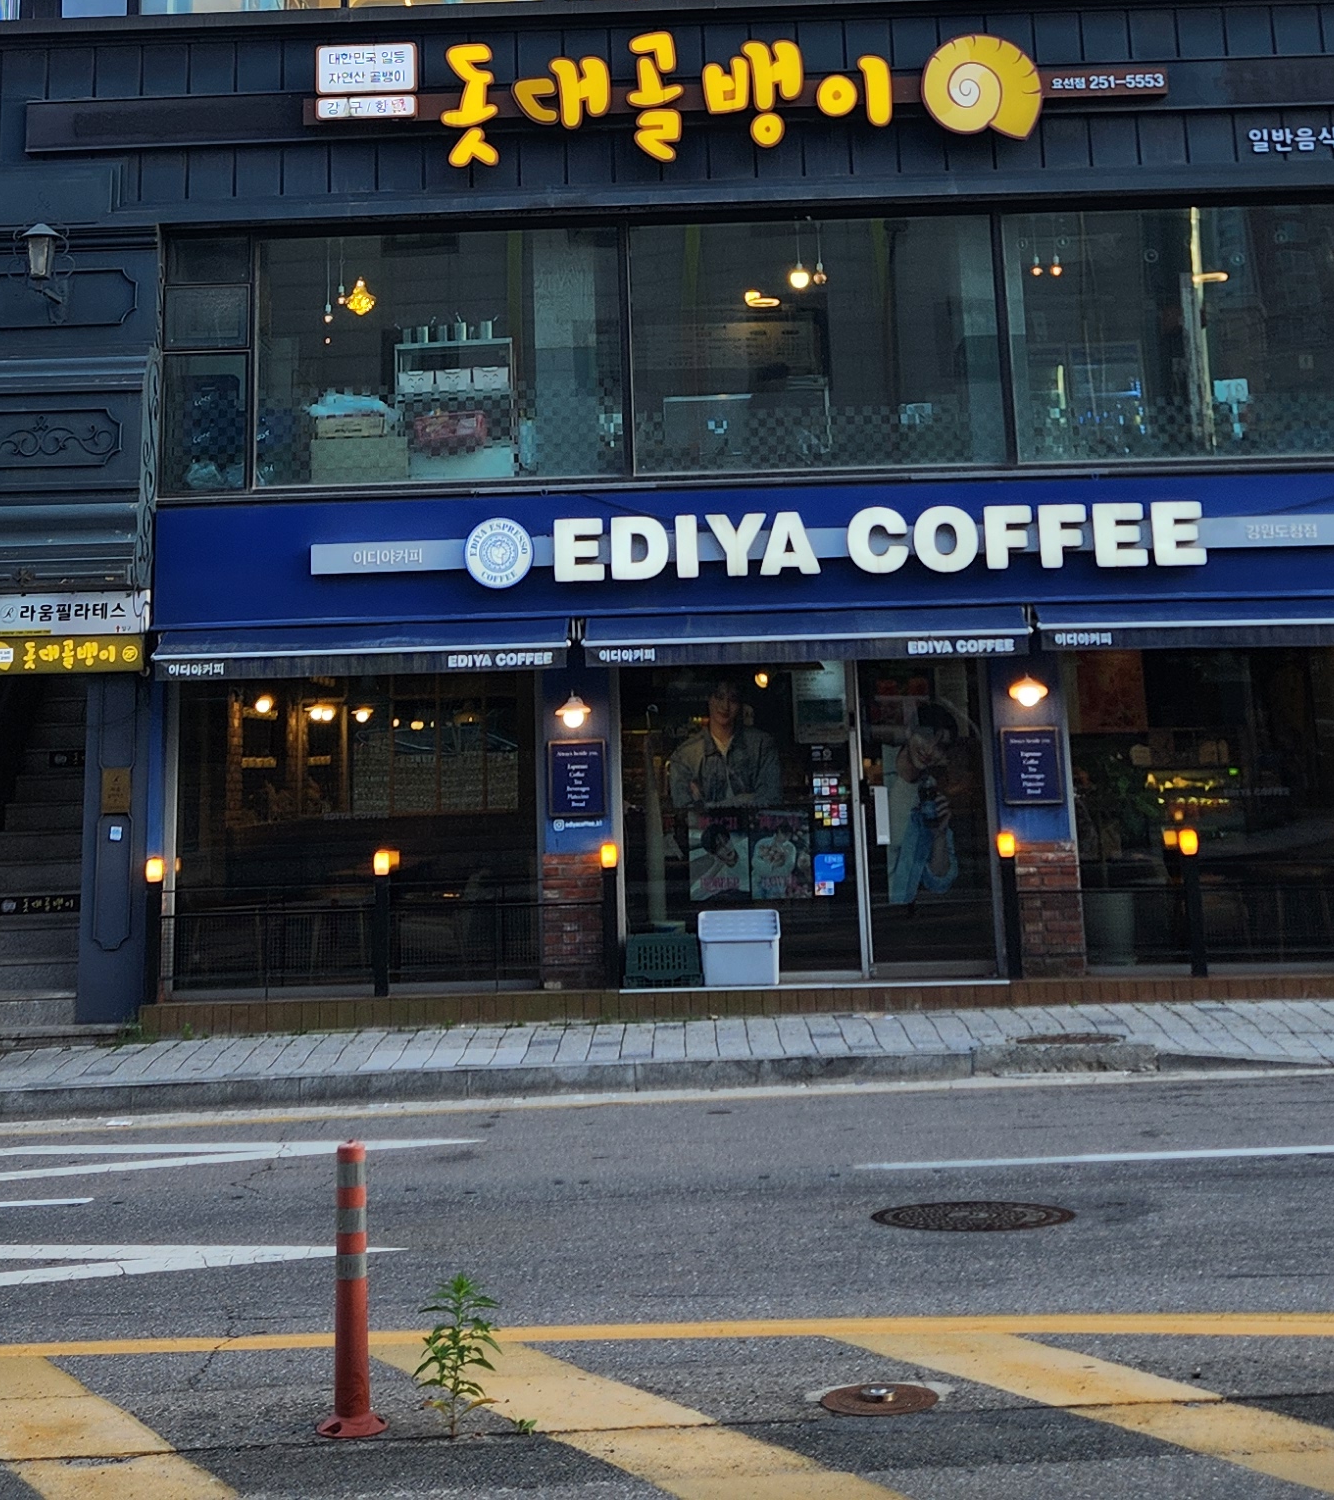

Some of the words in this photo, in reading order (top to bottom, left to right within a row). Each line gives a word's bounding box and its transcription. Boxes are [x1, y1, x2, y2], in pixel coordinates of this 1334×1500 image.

[328, 52, 376, 65] 대한민국
[381, 51, 405, 64] 일등
[328, 71, 366, 84] 자연산
[370, 70, 405, 83] 골뱅이
[1051, 76, 1086, 89] 요선점
[1089, 73, 1165, 89] 251-5553
[470, 529, 488, 557] EDIYA
[489, 522, 528, 555] ESPRESSO
[1246, 523, 1317, 540] 강원도청점
[552, 510, 821, 582] EDIYA
[847, 500, 1208, 573] COFFEE
[353, 548, 423, 565] 이디야커피
[20, 602, 126, 622] 라움필라테스
[908, 640, 953, 654] EDIYA
[956, 638, 1015, 653] COFFEE
[1055, 632, 1112, 646] 이디야커피
[448, 655, 492, 668] EDIYA
[495, 652, 553, 667] COFFEE
[599, 648, 656, 662] 이디야커피
[168, 663, 225, 676] 이디야커피
